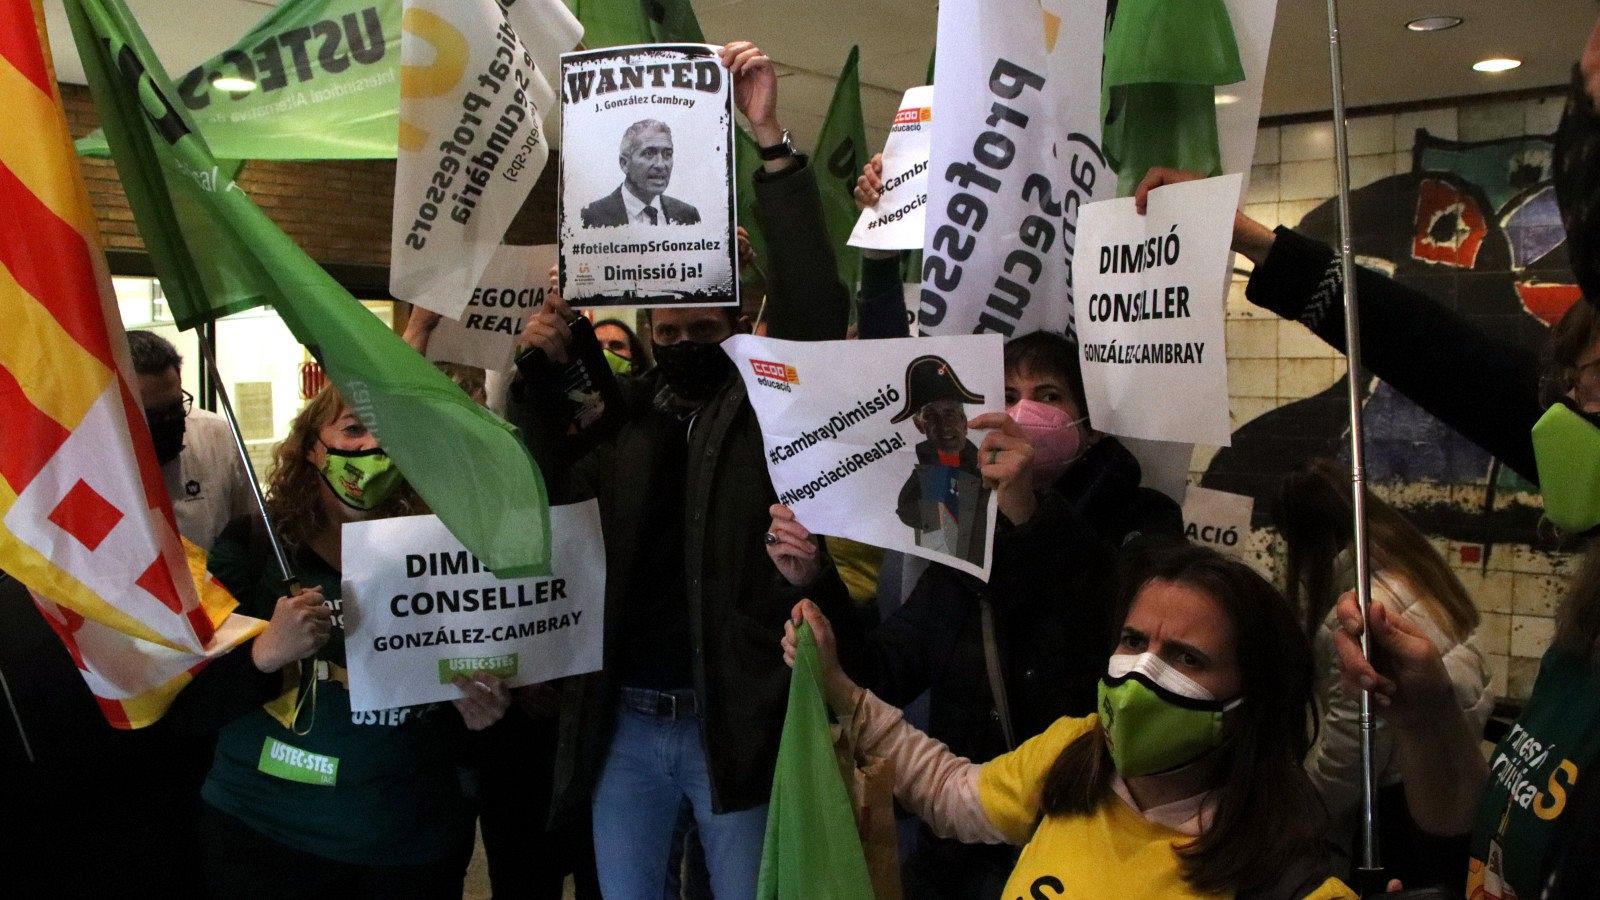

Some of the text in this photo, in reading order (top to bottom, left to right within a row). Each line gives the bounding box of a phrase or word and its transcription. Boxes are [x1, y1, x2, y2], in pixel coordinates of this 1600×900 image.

[567, 61, 721, 104] WANTED
[595, 94, 695, 112] J. González Cambray
[572, 239, 721, 255] #fotielcampSrGonzalez
[604, 262, 703, 282] Dimissió ja!
[754, 363, 785, 376] CCOO
[757, 377, 791, 393] educació
[769, 384, 900, 465] #CambrayDimissió
[780, 432, 906, 507] #NegociacióRealJa!
[405, 551, 492, 578] DIMI
[390, 579, 567, 617] CONSELLER
[373, 611, 582, 651] GONZÁLEZ-CAMBRAY
